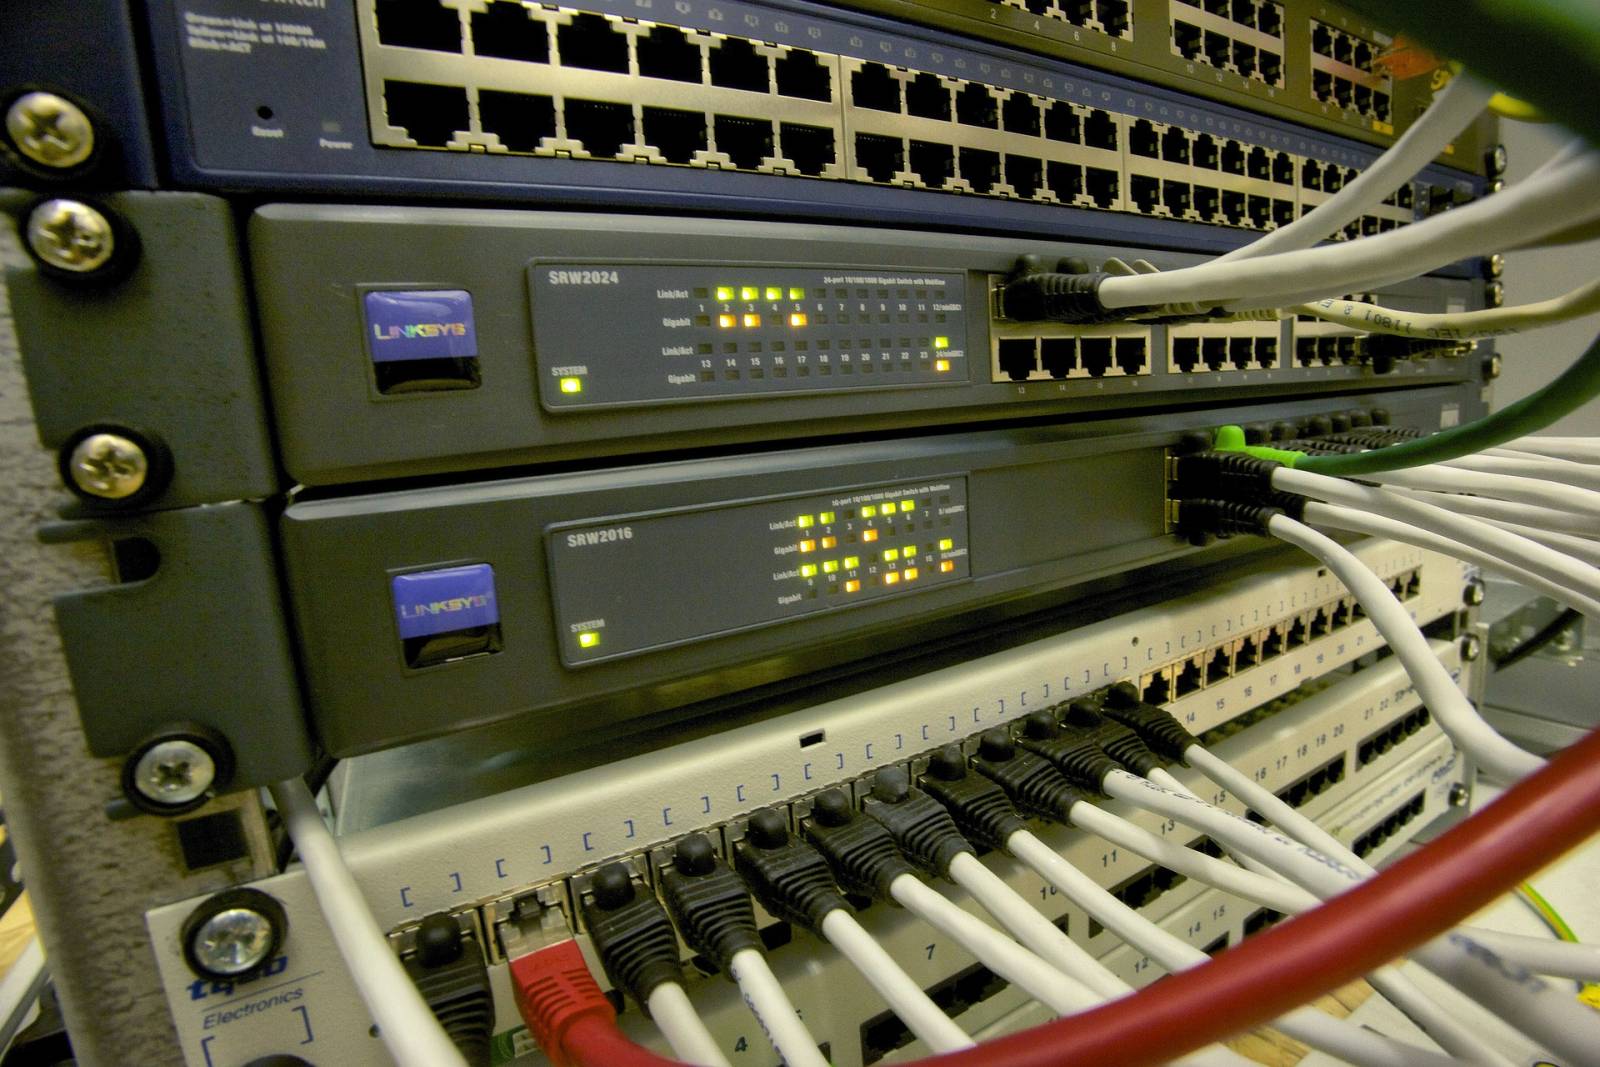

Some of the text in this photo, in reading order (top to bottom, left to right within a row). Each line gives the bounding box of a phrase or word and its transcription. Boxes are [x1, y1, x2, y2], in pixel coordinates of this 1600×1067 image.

[990, 8, 996, 19] 2
[1033, 20, 1040, 31] 4
[548, 270, 619, 285] SRW2024
[656, 289, 689, 299] Link/Act
[724, 304, 730, 312] 2
[748, 304, 754, 312] 3
[795, 303, 801, 311] 5
[662, 317, 691, 328] Gigabit
[374, 323, 466, 340] LINKSYS
[701, 360, 712, 368] 13
[726, 359, 737, 367] 14
[750, 357, 761, 366] 15
[774, 356, 785, 365] 16
[797, 355, 807, 364] 17
[551, 366, 588, 376] SYSTEM
[567, 527, 633, 548] SRW2016
[774, 544, 798, 555] Gigabit
[869, 566, 877, 574] 12
[400, 594, 488, 619] LINKSYS
[570, 618, 605, 633] SYSTEM
[1186, 712, 1195, 723] 14
[1216, 698, 1225, 710] 15
[1244, 686, 1252, 697] 16
[1040, 886, 1057, 900] 10
[1102, 848, 1117, 867] 11
[1161, 819, 1175, 835] 13
[1214, 790, 1226, 805] 15
[1256, 767, 1266, 781] 16
[1276, 755, 1287, 769] 17
[1297, 744, 1307, 758] 18
[1317, 733, 1326, 747] 19
[1333, 723, 1344, 738] 20
[1134, 904, 1225, 973] 12 14 15
[925, 943, 936, 960] 7
[186, 955, 288, 1001] tyo
[203, 987, 303, 1030] Electronics
[735, 1036, 747, 1053] 4
